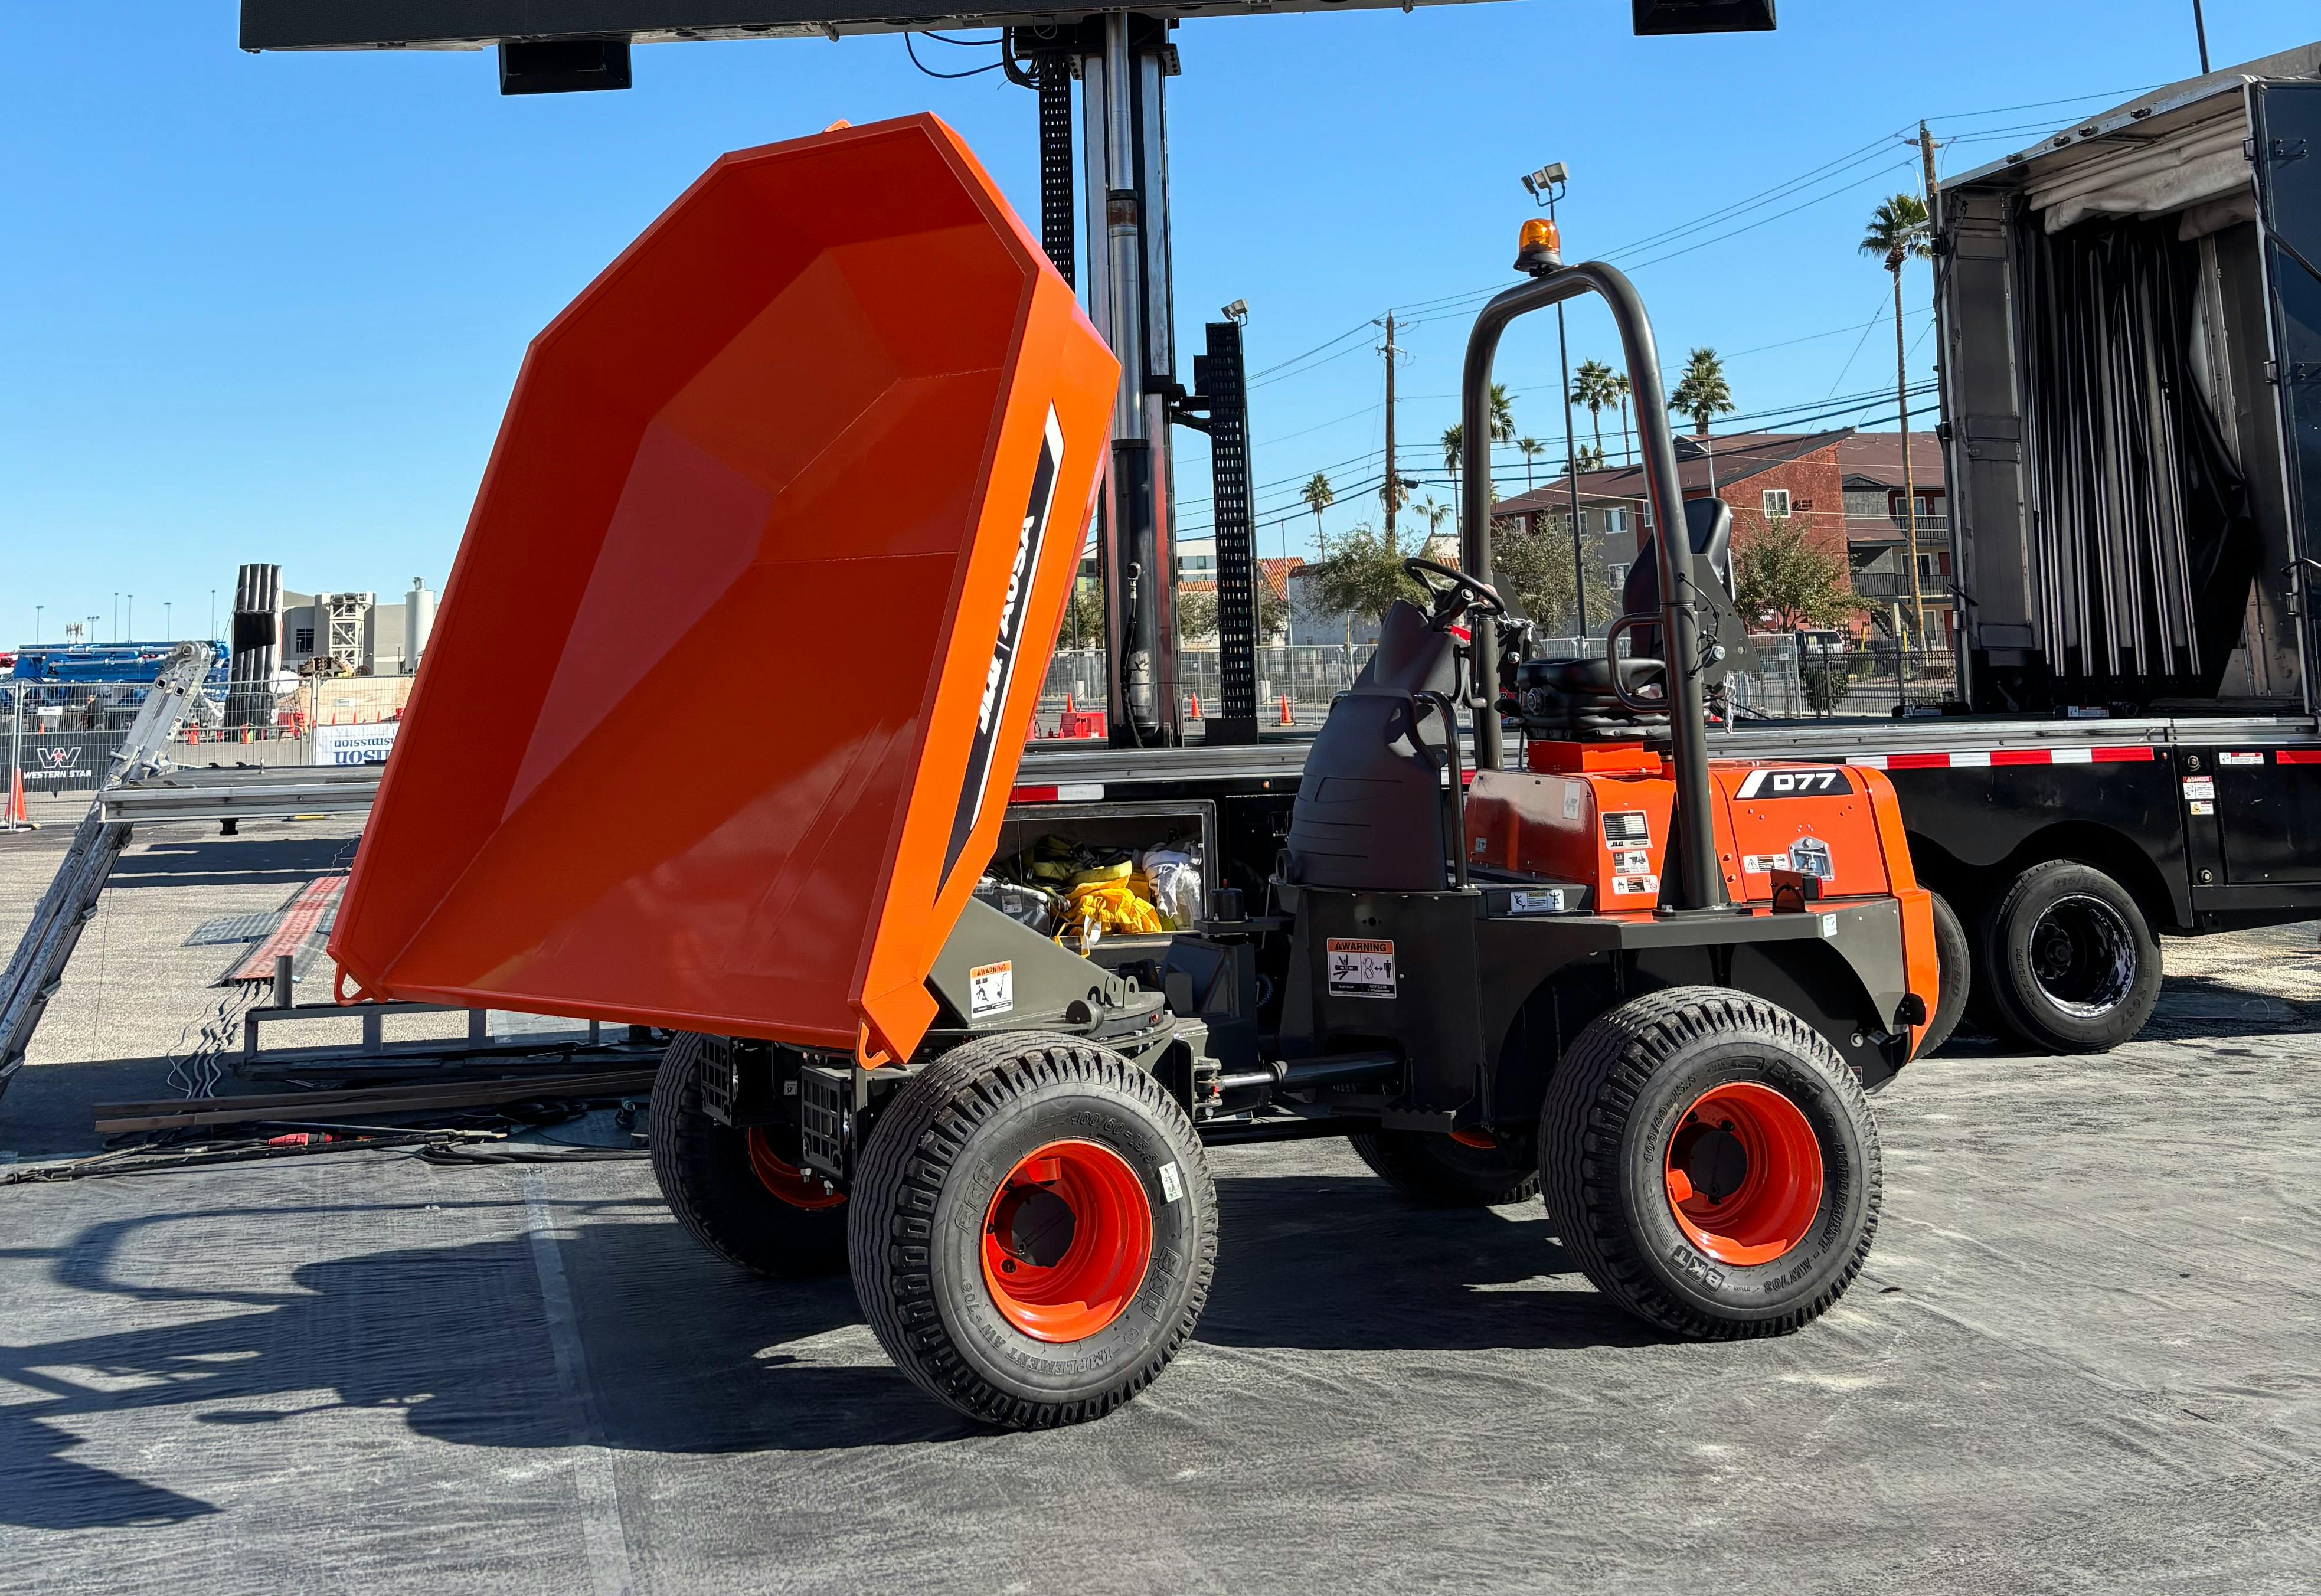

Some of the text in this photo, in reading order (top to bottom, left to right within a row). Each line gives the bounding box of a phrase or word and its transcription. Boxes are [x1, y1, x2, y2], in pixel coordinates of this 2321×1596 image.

[999, 515, 1035, 639] AUSA
[24, 769, 92, 779] WESTERN STAR
[1773, 773, 1836, 791] D77
[1341, 943, 1387, 951] WARNING
[980, 964, 1006, 975] WARNING
[1770, 1058, 1825, 1100] BKT
[1668, 1245, 1725, 1293] BKT
[1005, 1346, 1112, 1375] IMPLEMENT
